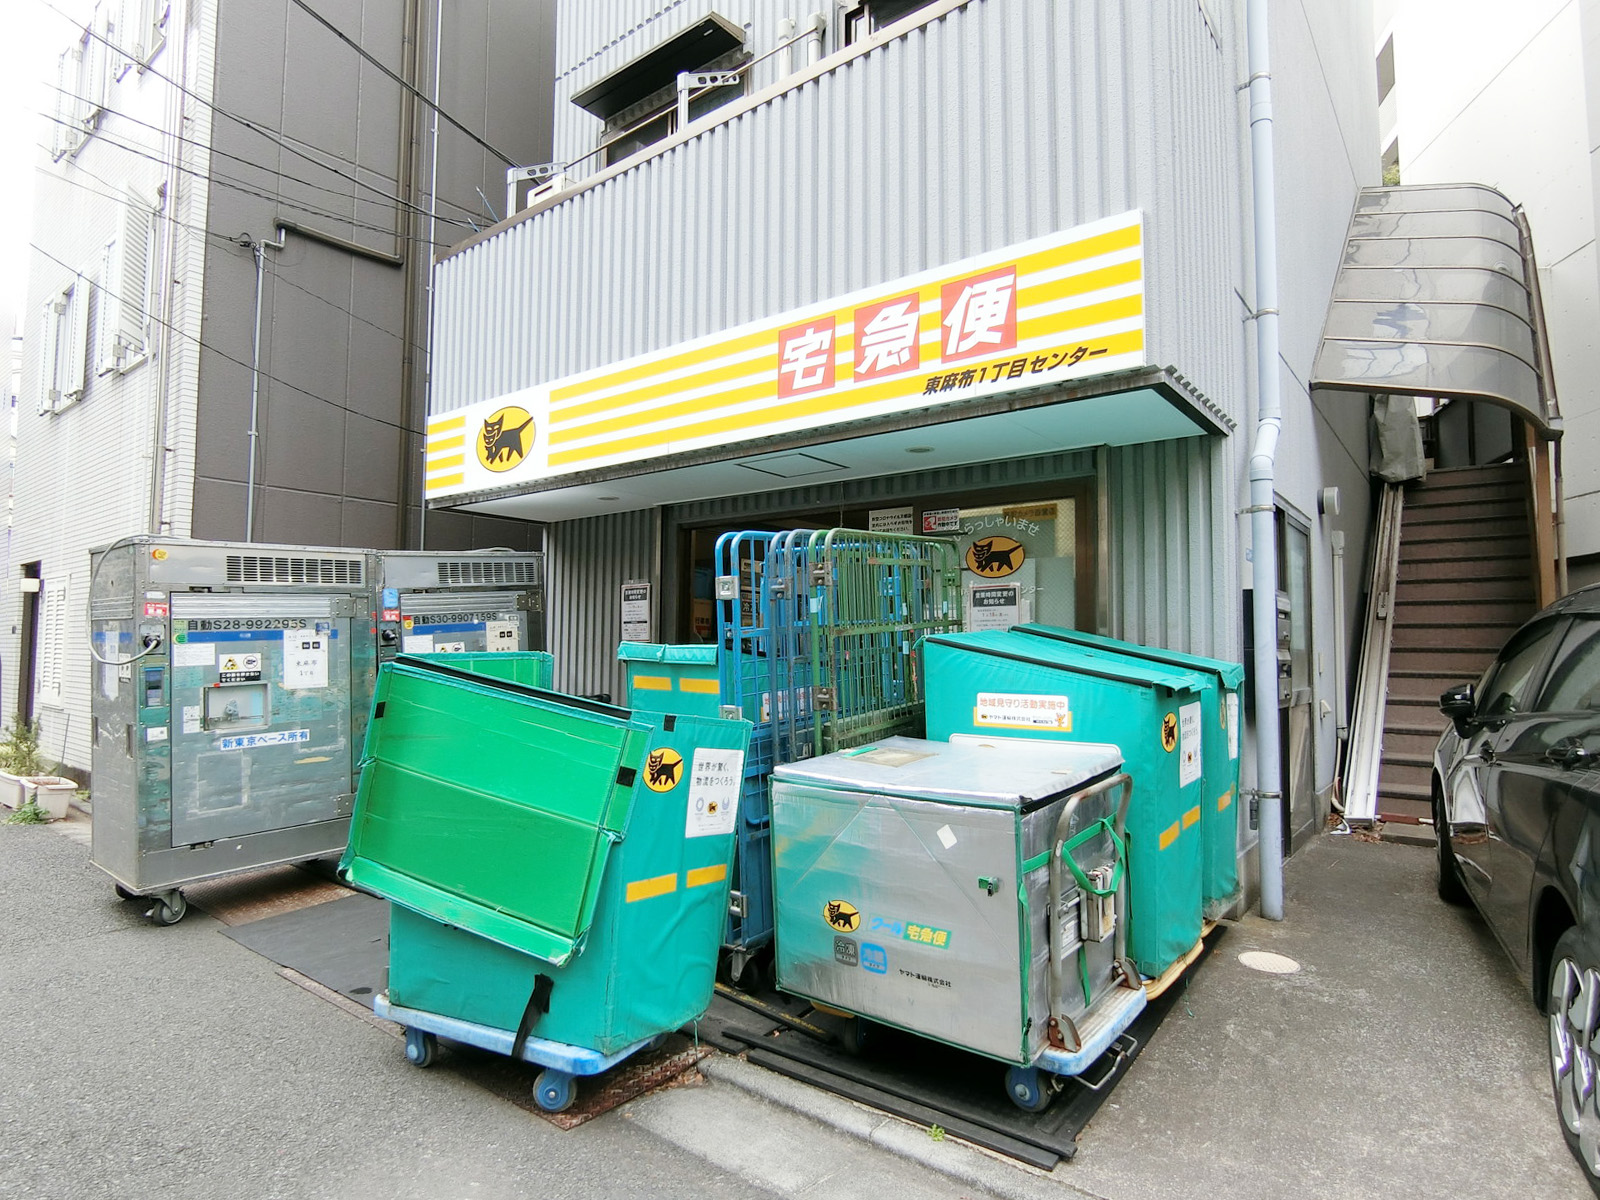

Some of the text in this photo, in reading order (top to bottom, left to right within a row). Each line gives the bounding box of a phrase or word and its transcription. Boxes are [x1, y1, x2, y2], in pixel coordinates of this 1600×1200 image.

[780, 273, 1015, 391] 宅急便
[923, 346, 1108, 396] 東麻布1丁目センター
[188, 618, 307, 631] 自動S28-992295S
[413, 613, 498, 625] 自動S30-9907159S
[980, 697, 1065, 710] 地域見守り活動実施中
[222, 731, 309, 749] 新東京ベース所有
[698, 762, 730, 772] 世界が驚く、
[696, 776, 736, 787] 物流をつくろう。
[836, 939, 856, 957] 冷凍
[899, 968, 951, 988] ヤマト運輸株式会社
